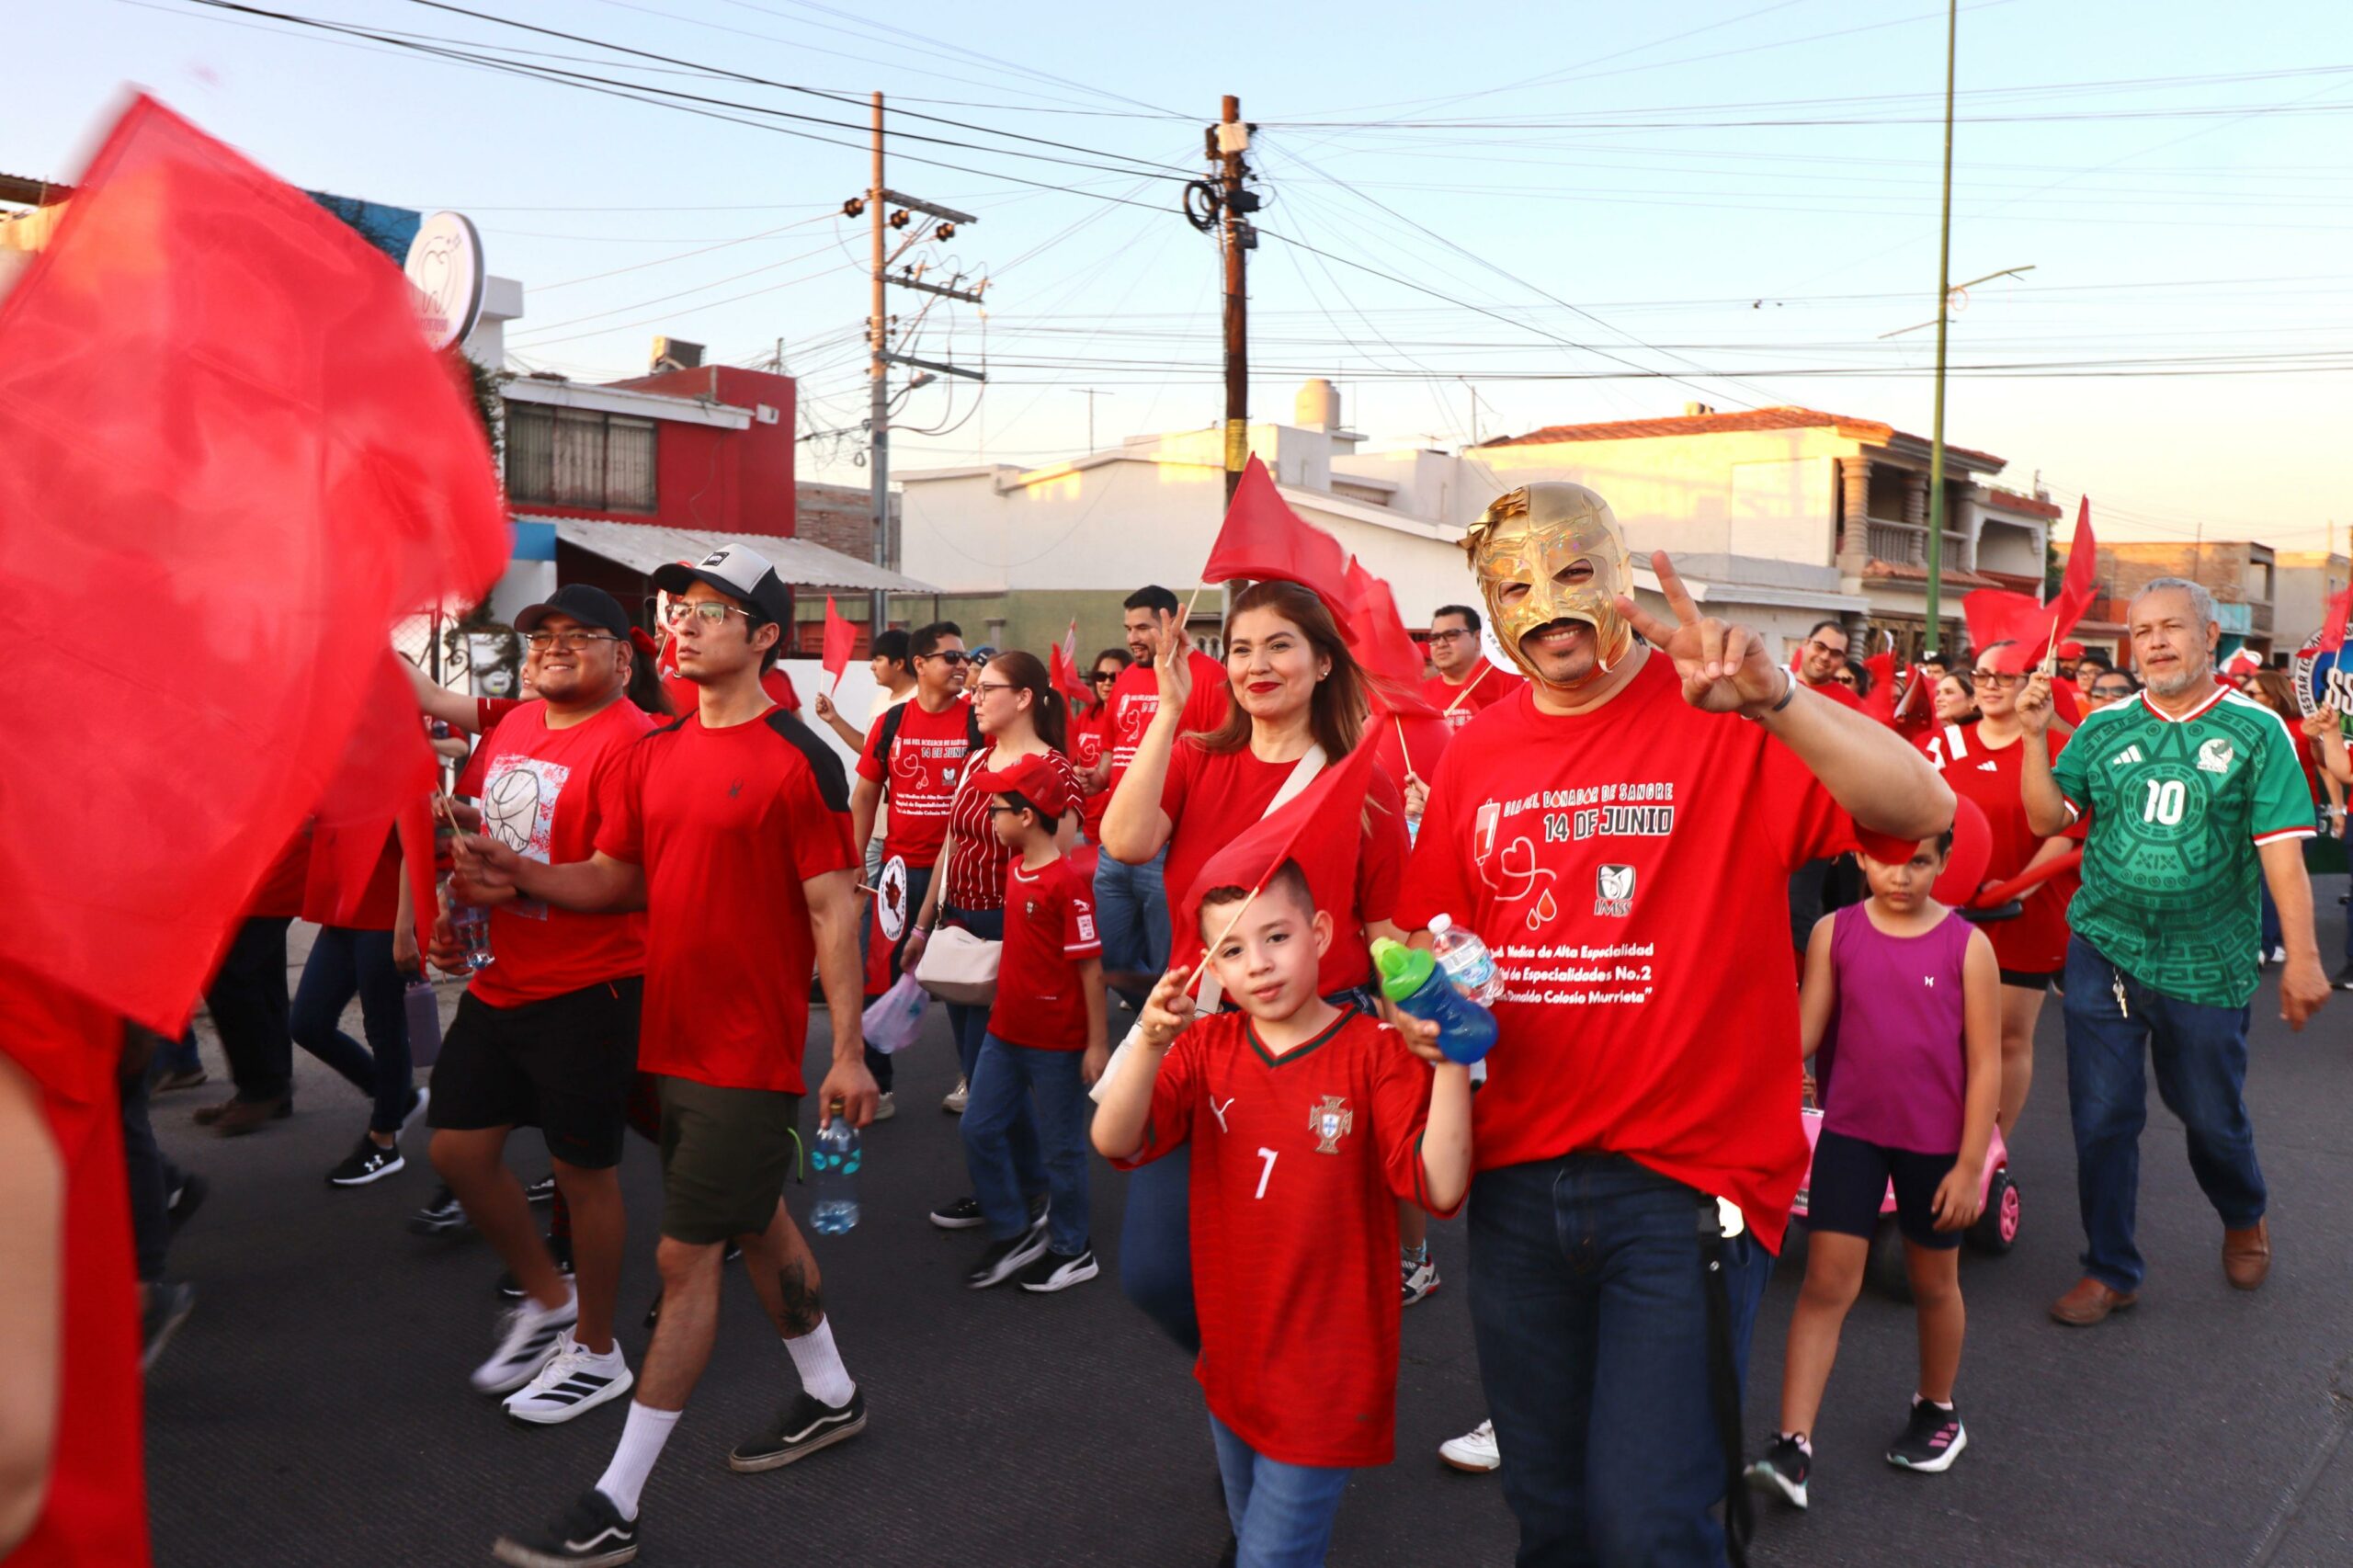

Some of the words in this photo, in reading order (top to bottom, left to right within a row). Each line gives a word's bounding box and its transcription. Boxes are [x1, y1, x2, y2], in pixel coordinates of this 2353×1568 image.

[921, 747, 931, 758] 14
[932, 747, 943, 758] DE
[943, 746, 967, 758] JUNI
[1542, 787, 1598, 809] DONADOR
[1601, 784, 1617, 802] DE
[1619, 782, 1674, 801] SANGRE
[2143, 778, 2186, 825] 10
[1543, 813, 1570, 843] 14
[1573, 808, 1599, 841] DE
[1598, 805, 1675, 835] JUNIO
[1594, 898, 1633, 917] IMSS
[1537, 944, 1553, 959] de
[1553, 944, 1578, 959] Alta
[1580, 943, 1654, 961] Especialidad
[1522, 967, 1612, 984] Especialidades
[1615, 966, 1652, 982] No.2
[1543, 990, 1586, 1005] Colosio
[1255, 1147, 1279, 1199] 7
